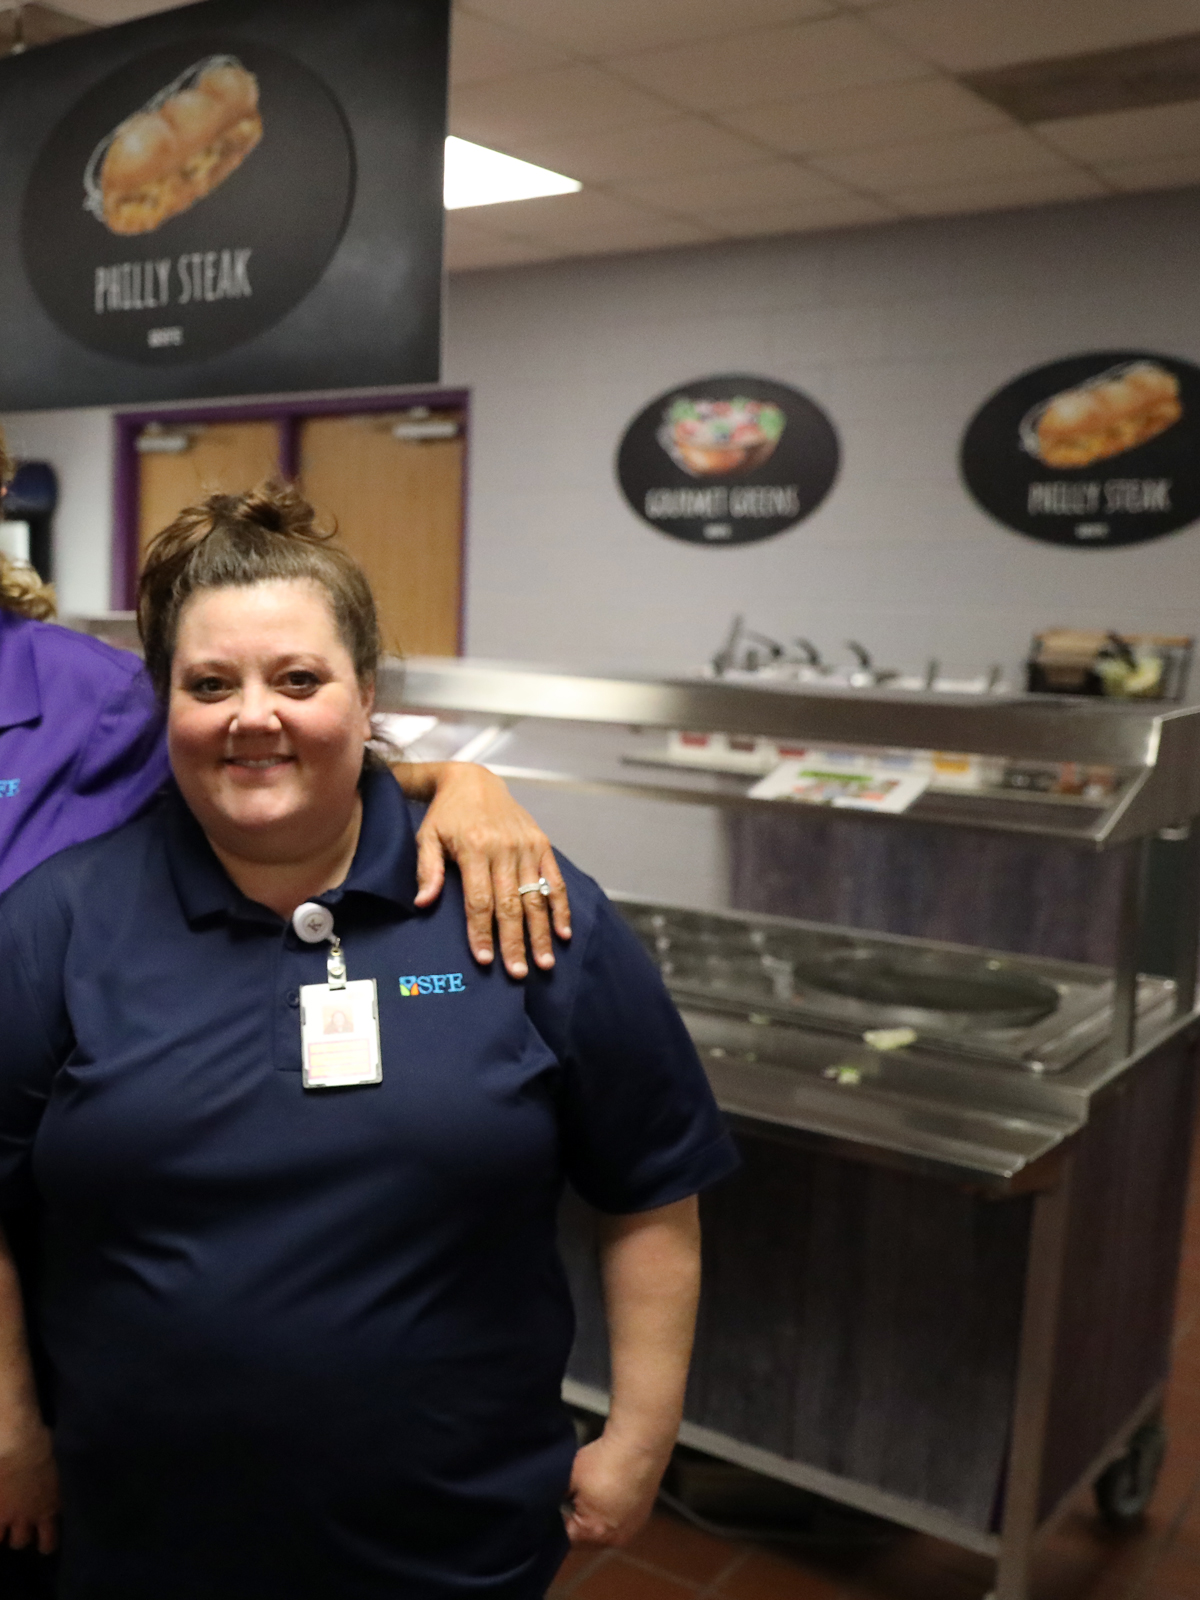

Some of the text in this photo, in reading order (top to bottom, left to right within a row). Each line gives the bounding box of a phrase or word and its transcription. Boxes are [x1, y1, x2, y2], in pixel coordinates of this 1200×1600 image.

[94, 247, 252, 315] PHILLY STEAK
[1028, 479, 1172, 515] PHILLY STEAK
[418, 973, 466, 995] SFE
